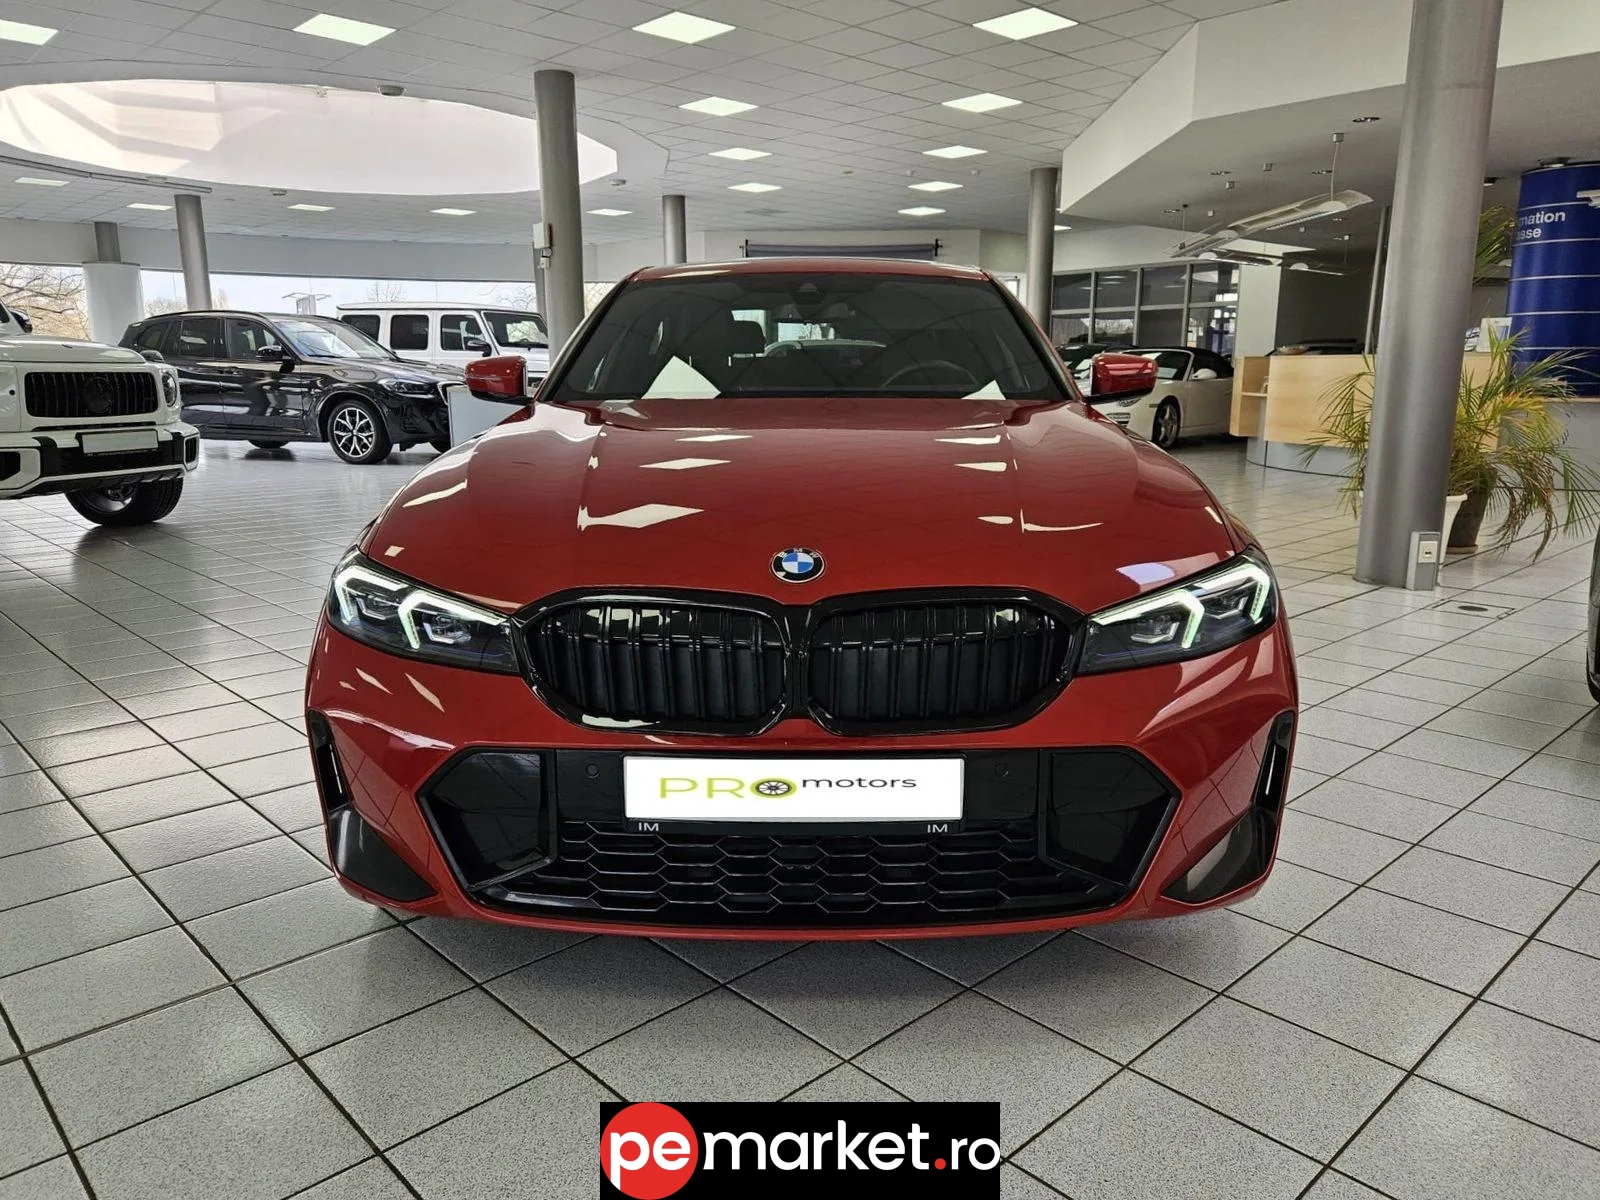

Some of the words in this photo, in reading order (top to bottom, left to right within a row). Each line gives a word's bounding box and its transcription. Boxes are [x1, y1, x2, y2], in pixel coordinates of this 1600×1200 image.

[659, 777, 798, 799] PRO
[802, 776, 918, 789] motors
[638, 822, 659, 831] IM
[927, 823, 948, 833] IM
